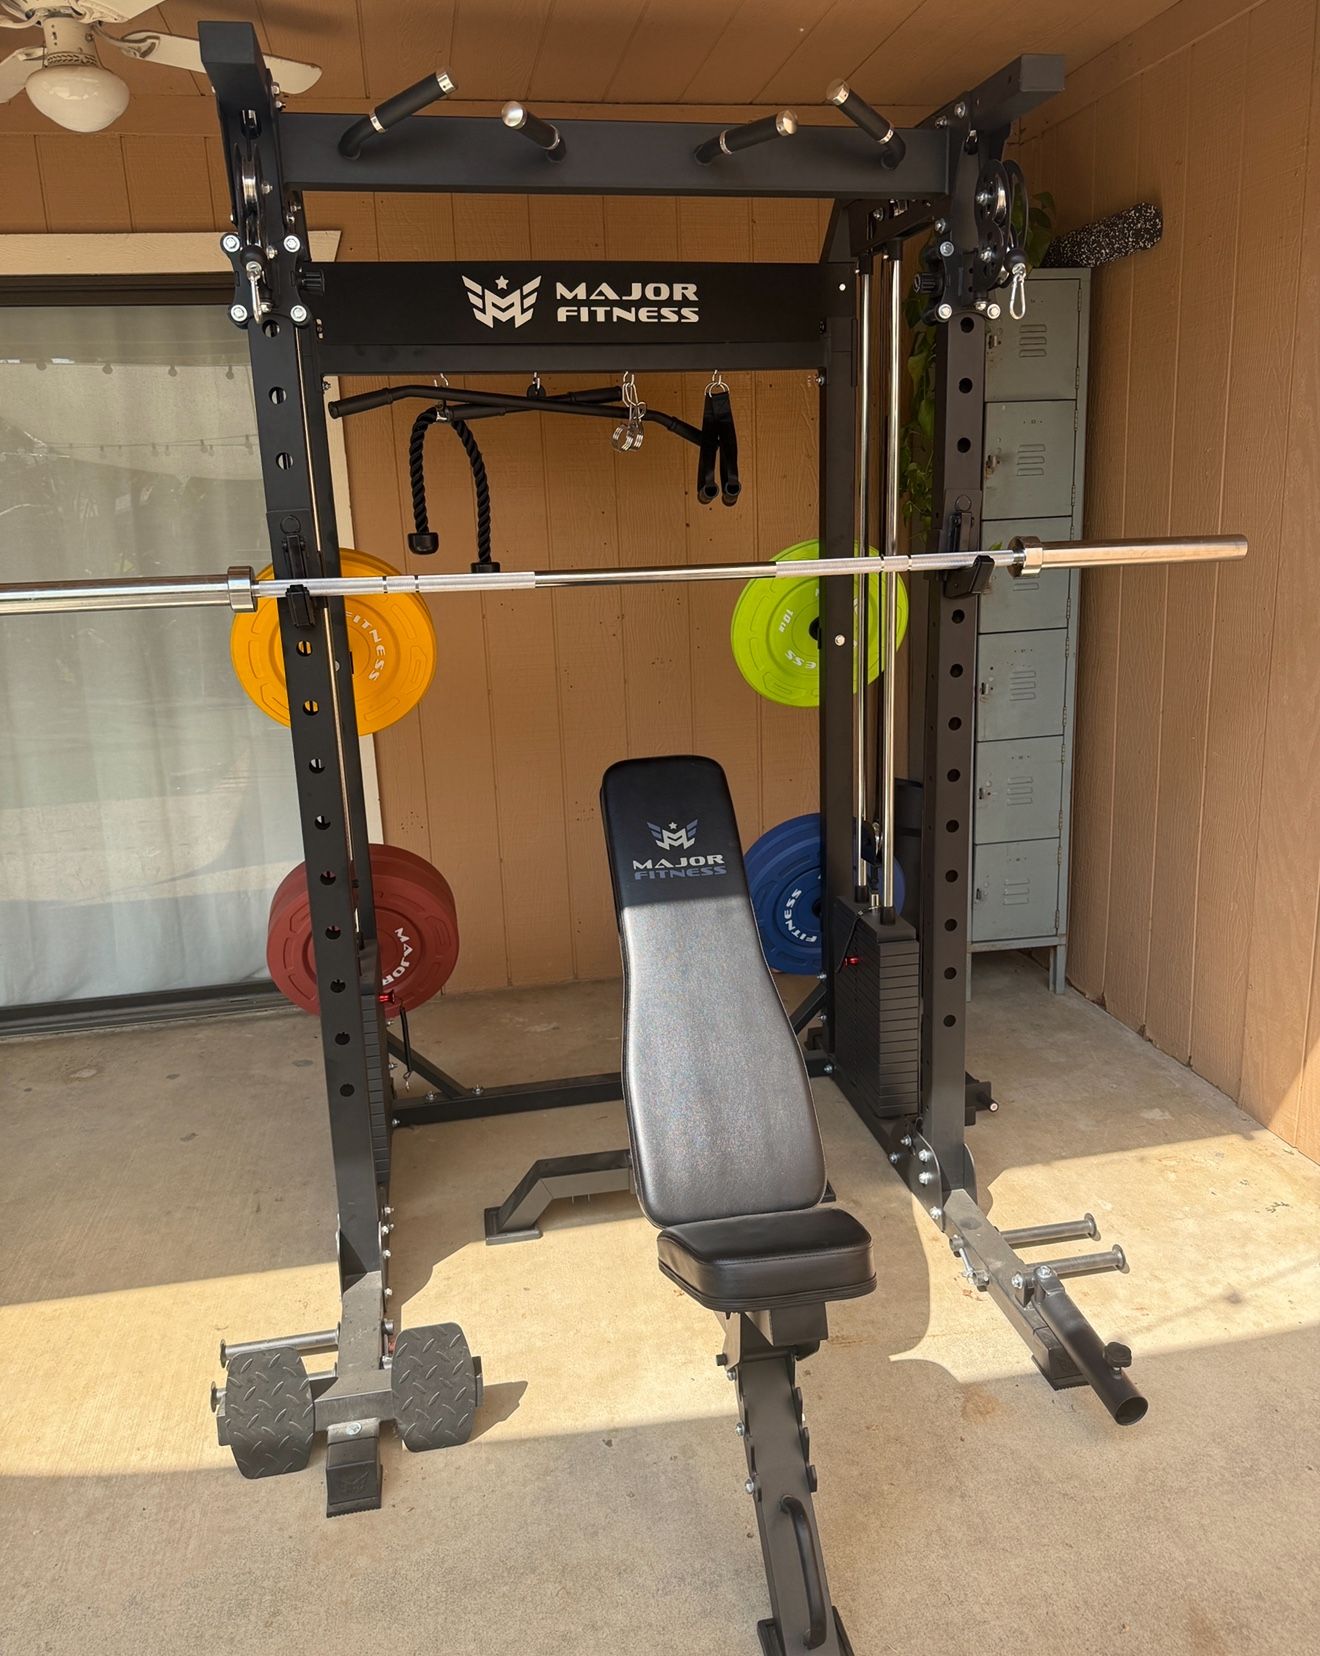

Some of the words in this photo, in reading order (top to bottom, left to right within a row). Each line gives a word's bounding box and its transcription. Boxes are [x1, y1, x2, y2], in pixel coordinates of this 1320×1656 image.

[556, 282, 699, 301] MAJOR
[556, 306, 700, 323] FITNESS
[632, 854, 725, 870] MAJOR
[634, 866, 728, 880] FITNESS
[784, 888, 818, 943] FITNESS
[382, 927, 413, 986] MAJOR
